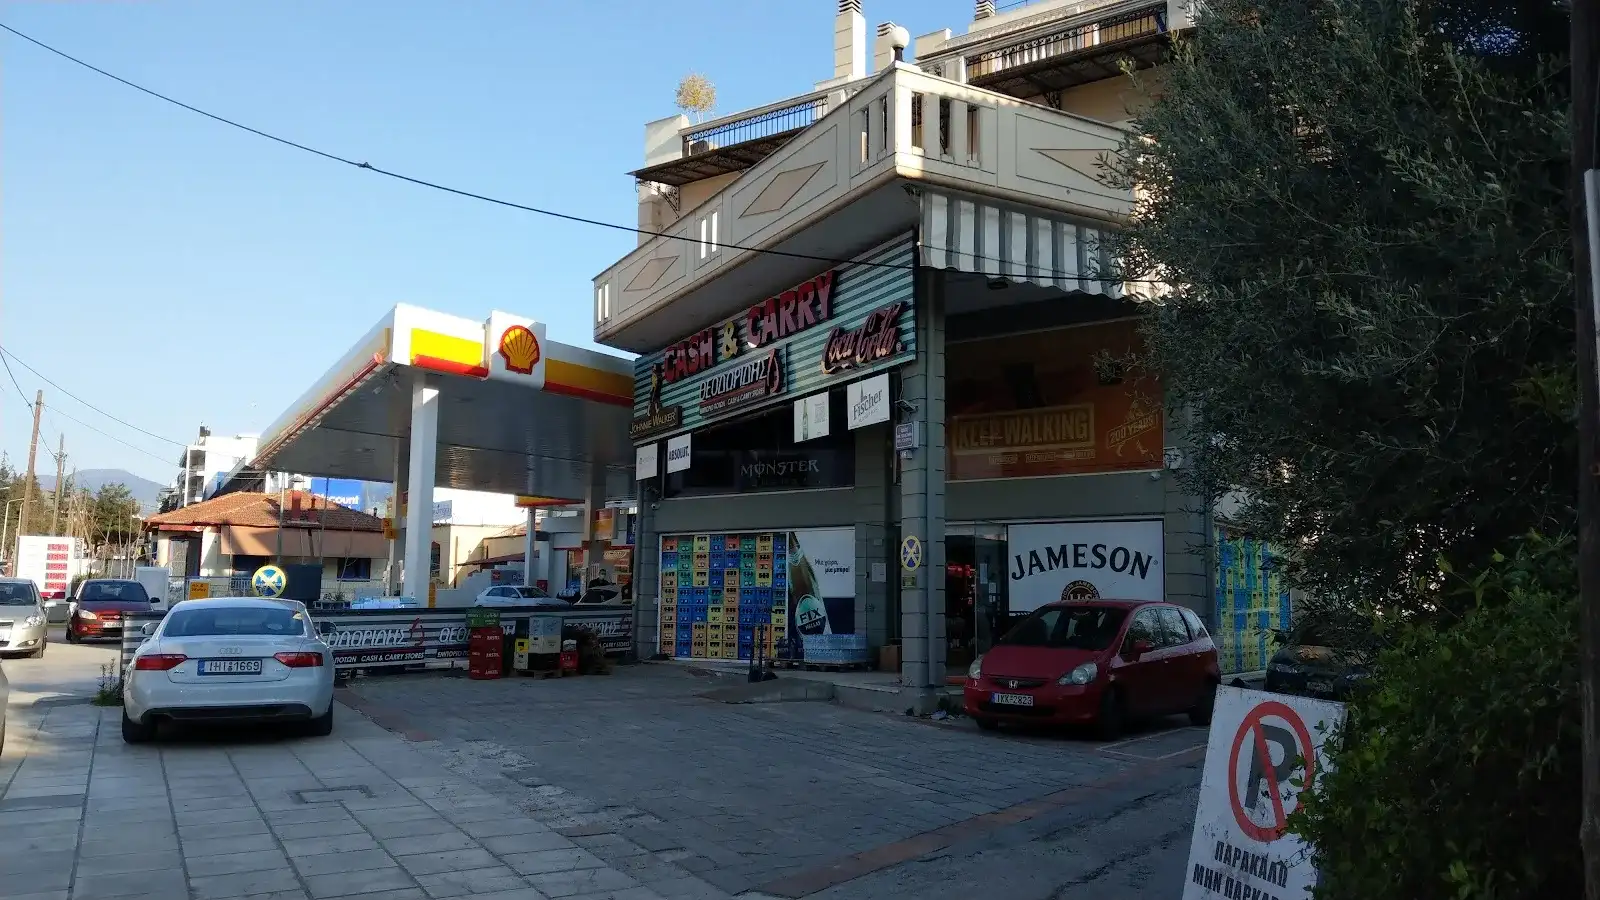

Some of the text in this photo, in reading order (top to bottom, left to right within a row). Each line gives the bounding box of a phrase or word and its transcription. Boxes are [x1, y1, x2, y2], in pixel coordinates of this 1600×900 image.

[664, 271, 838, 383] CASH & CARRY
[853, 388, 883, 421] Fischer
[1004, 410, 1089, 446] WALKING
[740, 459, 820, 478] MONSTER
[1011, 543, 1153, 581] JAMESON
[799, 607, 822, 624] FIX
[361, 655, 378, 663] CASH
[384, 653, 405, 662] CARRY
[1193, 863, 1223, 893] ΜΗΝ
